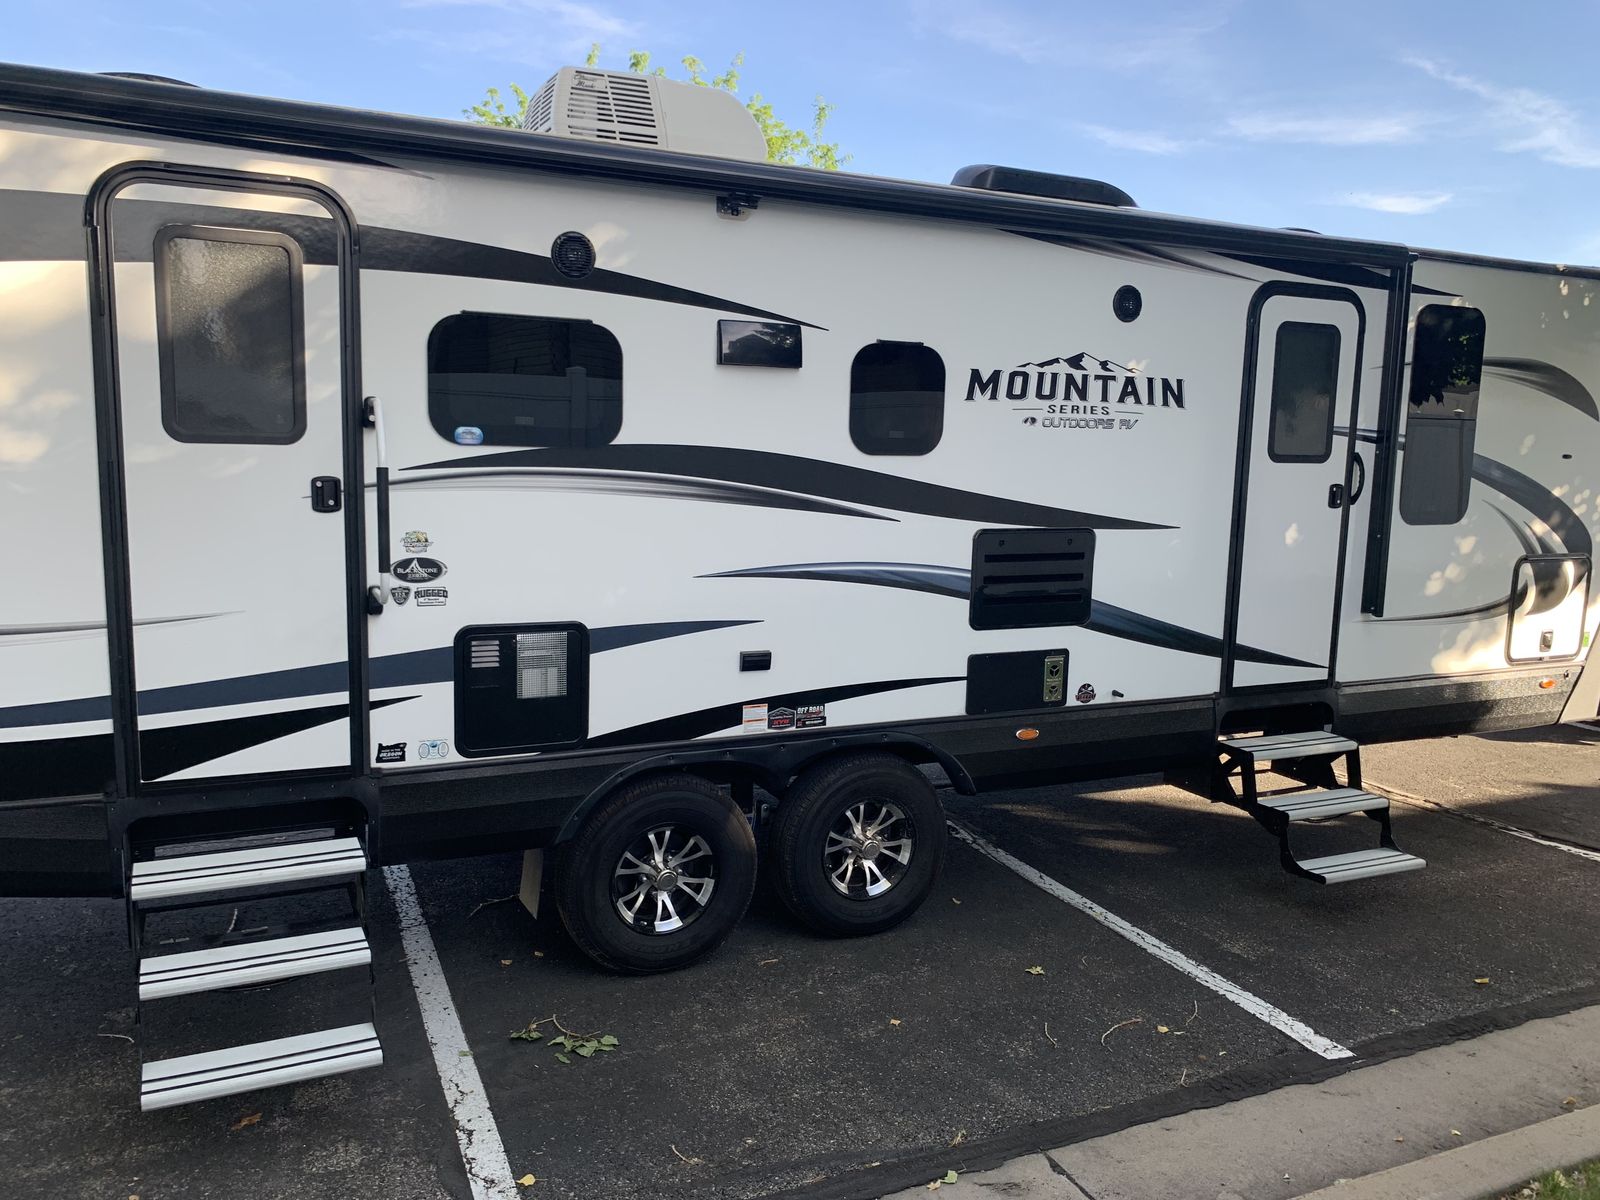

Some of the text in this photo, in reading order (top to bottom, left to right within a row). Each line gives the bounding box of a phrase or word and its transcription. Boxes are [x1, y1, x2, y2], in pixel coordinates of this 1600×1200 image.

[964, 368, 1186, 410] MOUNTAIN
[1047, 404, 1110, 415] SERIES
[1042, 418, 1139, 430] OUTDOORS RV
[414, 589, 448, 599] RUGGED
[797, 706, 808, 714] OFF
